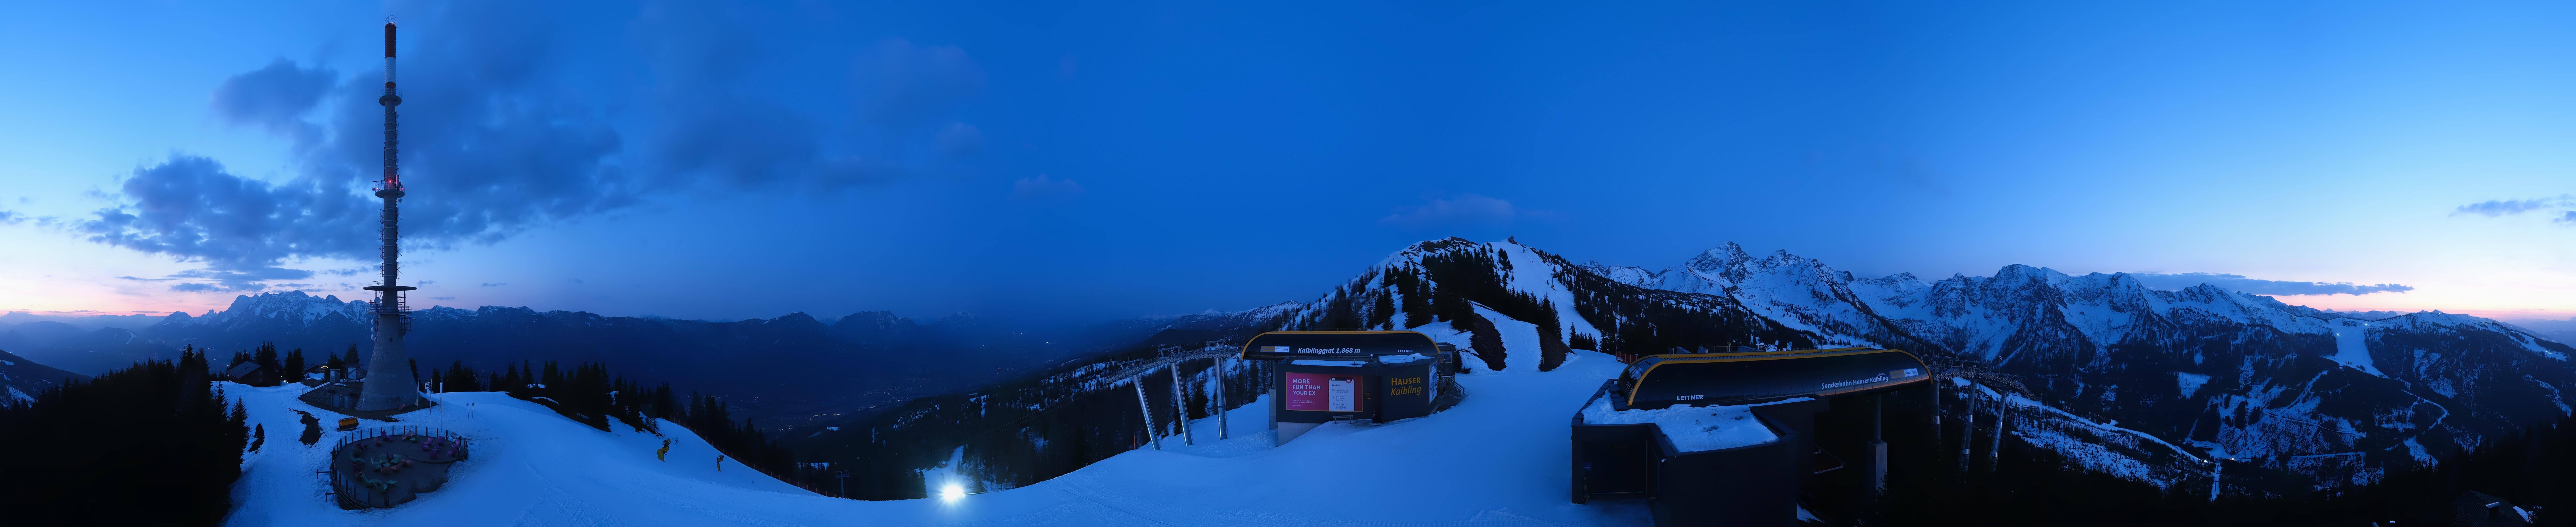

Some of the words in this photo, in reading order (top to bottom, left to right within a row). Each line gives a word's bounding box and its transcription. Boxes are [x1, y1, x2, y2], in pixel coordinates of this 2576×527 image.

[1391, 377, 1421, 386] HAUSER
[1821, 380, 1852, 389] Senderbahn
[1391, 386, 1421, 396] Kaibling
